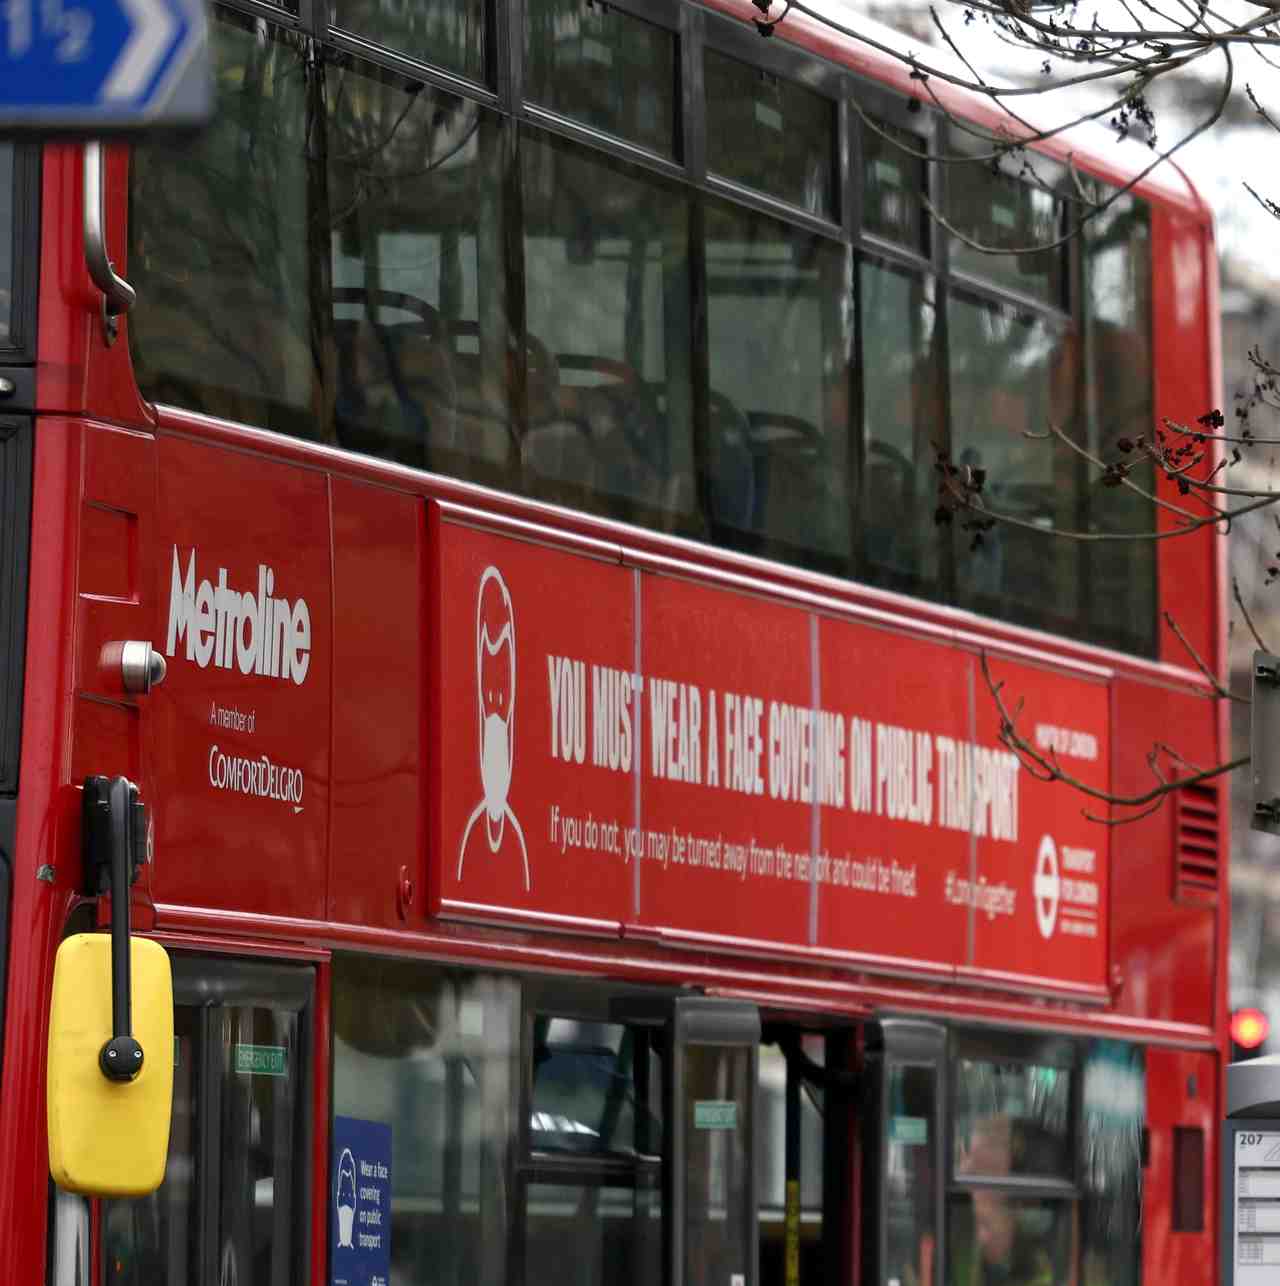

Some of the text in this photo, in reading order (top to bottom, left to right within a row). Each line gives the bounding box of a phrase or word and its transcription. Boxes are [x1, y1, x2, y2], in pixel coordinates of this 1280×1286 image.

[167, 543, 312, 686] Metroline
[209, 700, 256, 734] A member of
[547, 654, 1020, 842] YOU MUST WEAR A FACE COVERING ON PUBLIC TRANSPORT
[551, 804, 560, 844] If
[562, 816, 582, 855] you
[585, 811, 599, 850] do
[624, 827, 645, 865] you
[648, 829, 670, 871] may
[672, 826, 685, 864] be
[688, 832, 722, 869] turned
[723, 842, 748, 881] away
[750, 837, 775, 876] from
[1239, 1133, 1264, 1146] 207
